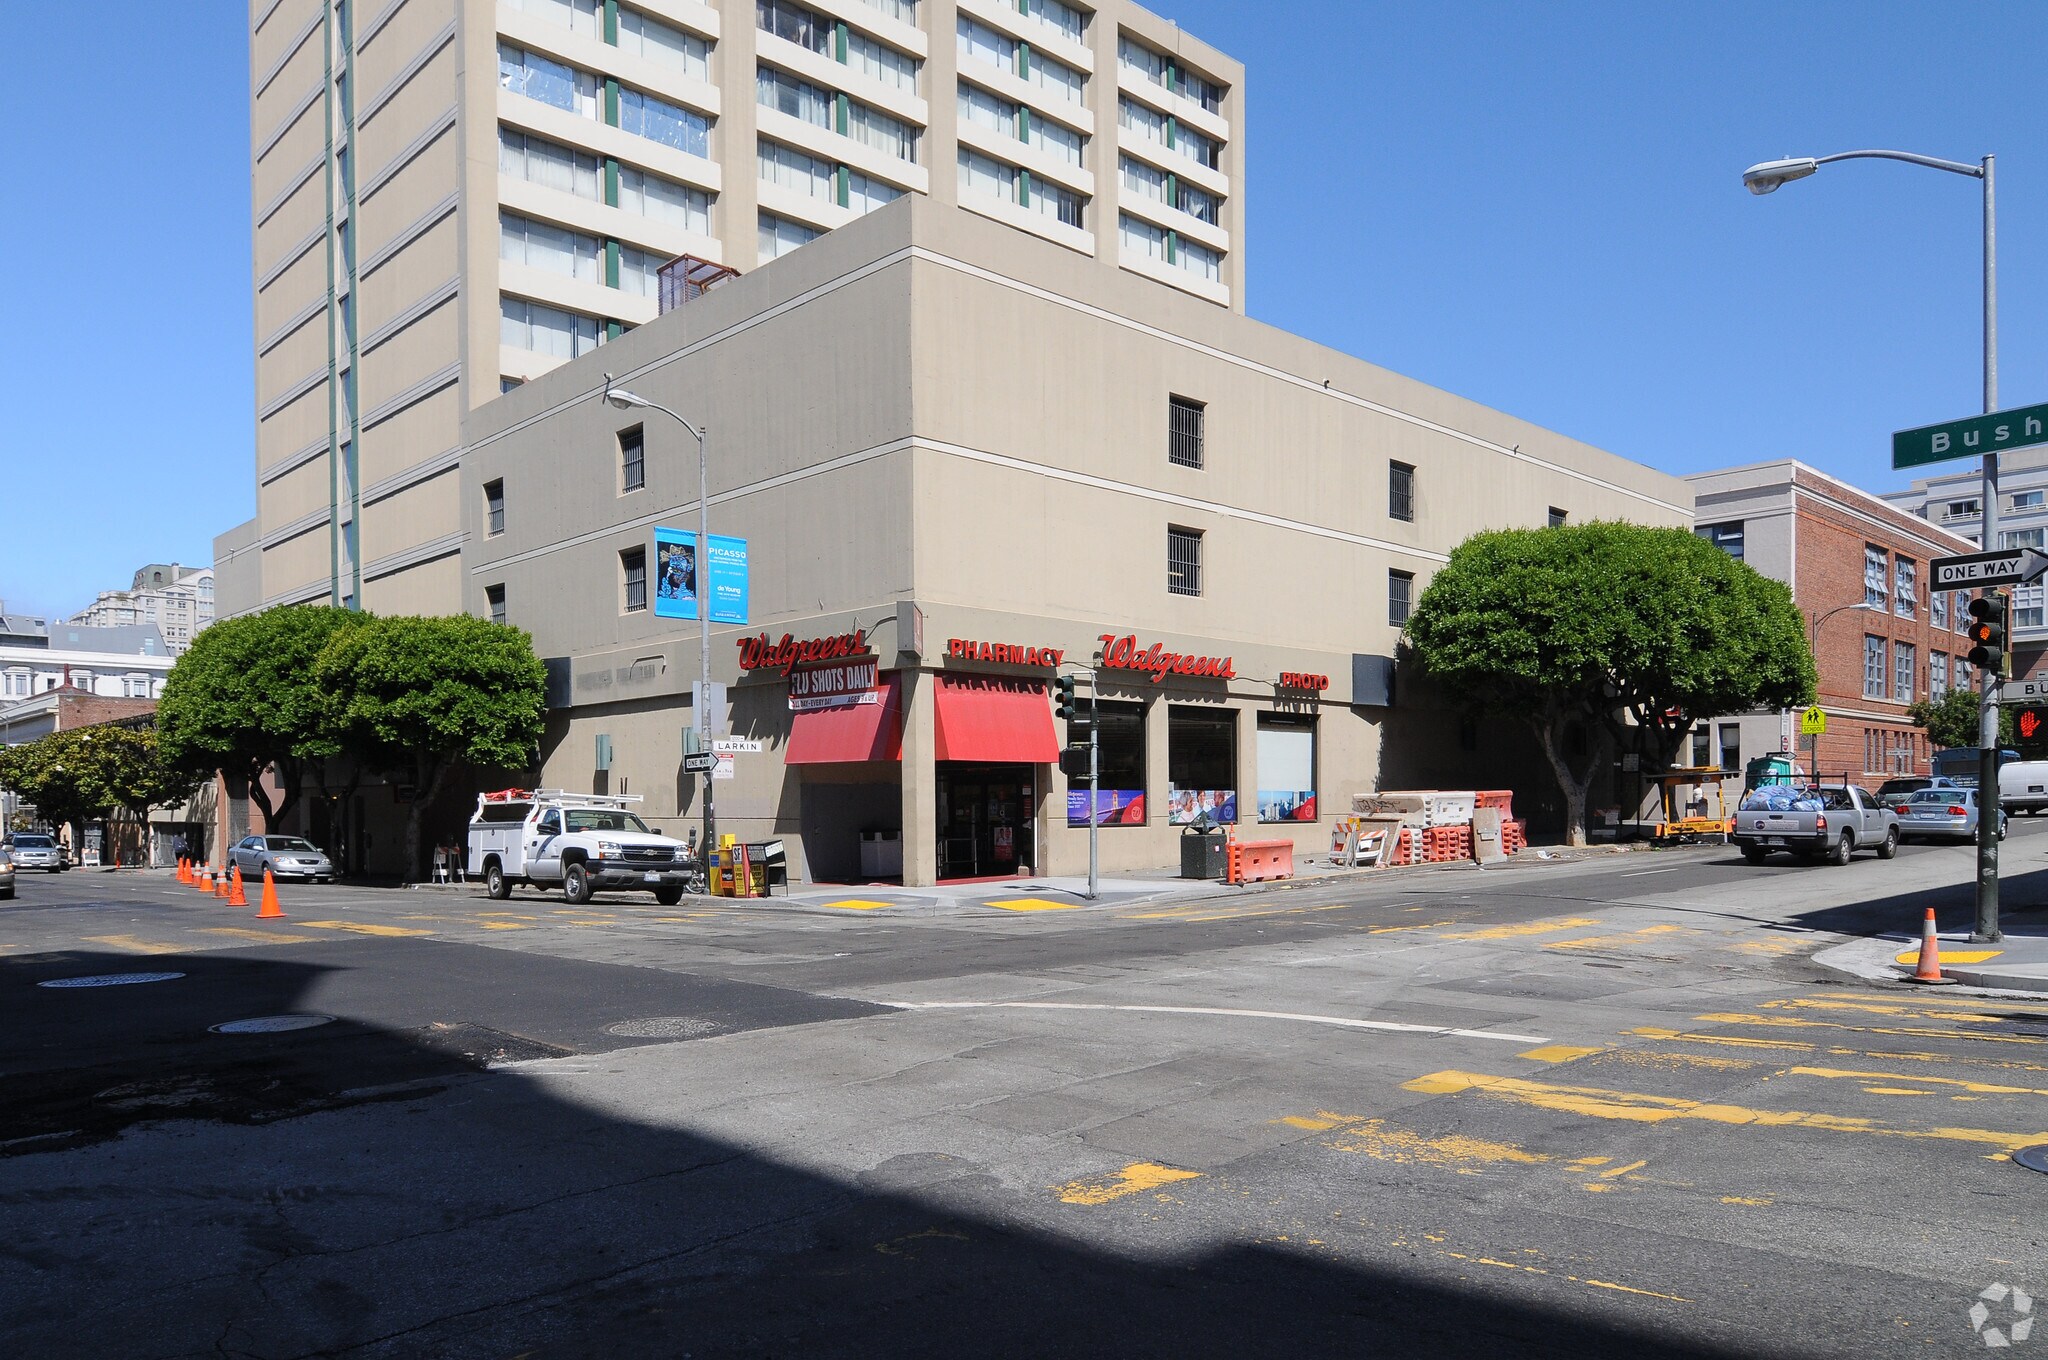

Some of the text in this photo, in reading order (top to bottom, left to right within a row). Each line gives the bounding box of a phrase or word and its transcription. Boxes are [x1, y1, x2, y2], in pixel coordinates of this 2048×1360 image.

[1931, 416, 2042, 454] Bush
[708, 547, 746, 559] PICASSO
[1943, 560, 2019, 580] ONE WAY
[725, 585, 741, 595] Young
[736, 629, 868, 676] Walgreens
[948, 638, 1065, 668] PHARMACY
[1099, 634, 1237, 683] Walgreens
[791, 663, 876, 695] FLU SHOTS DAILY
[1281, 672, 1329, 690] PHOTO
[718, 742, 757, 750] LARKIN
[687, 759, 698, 767] ONE
[734, 848, 741, 860] SF
